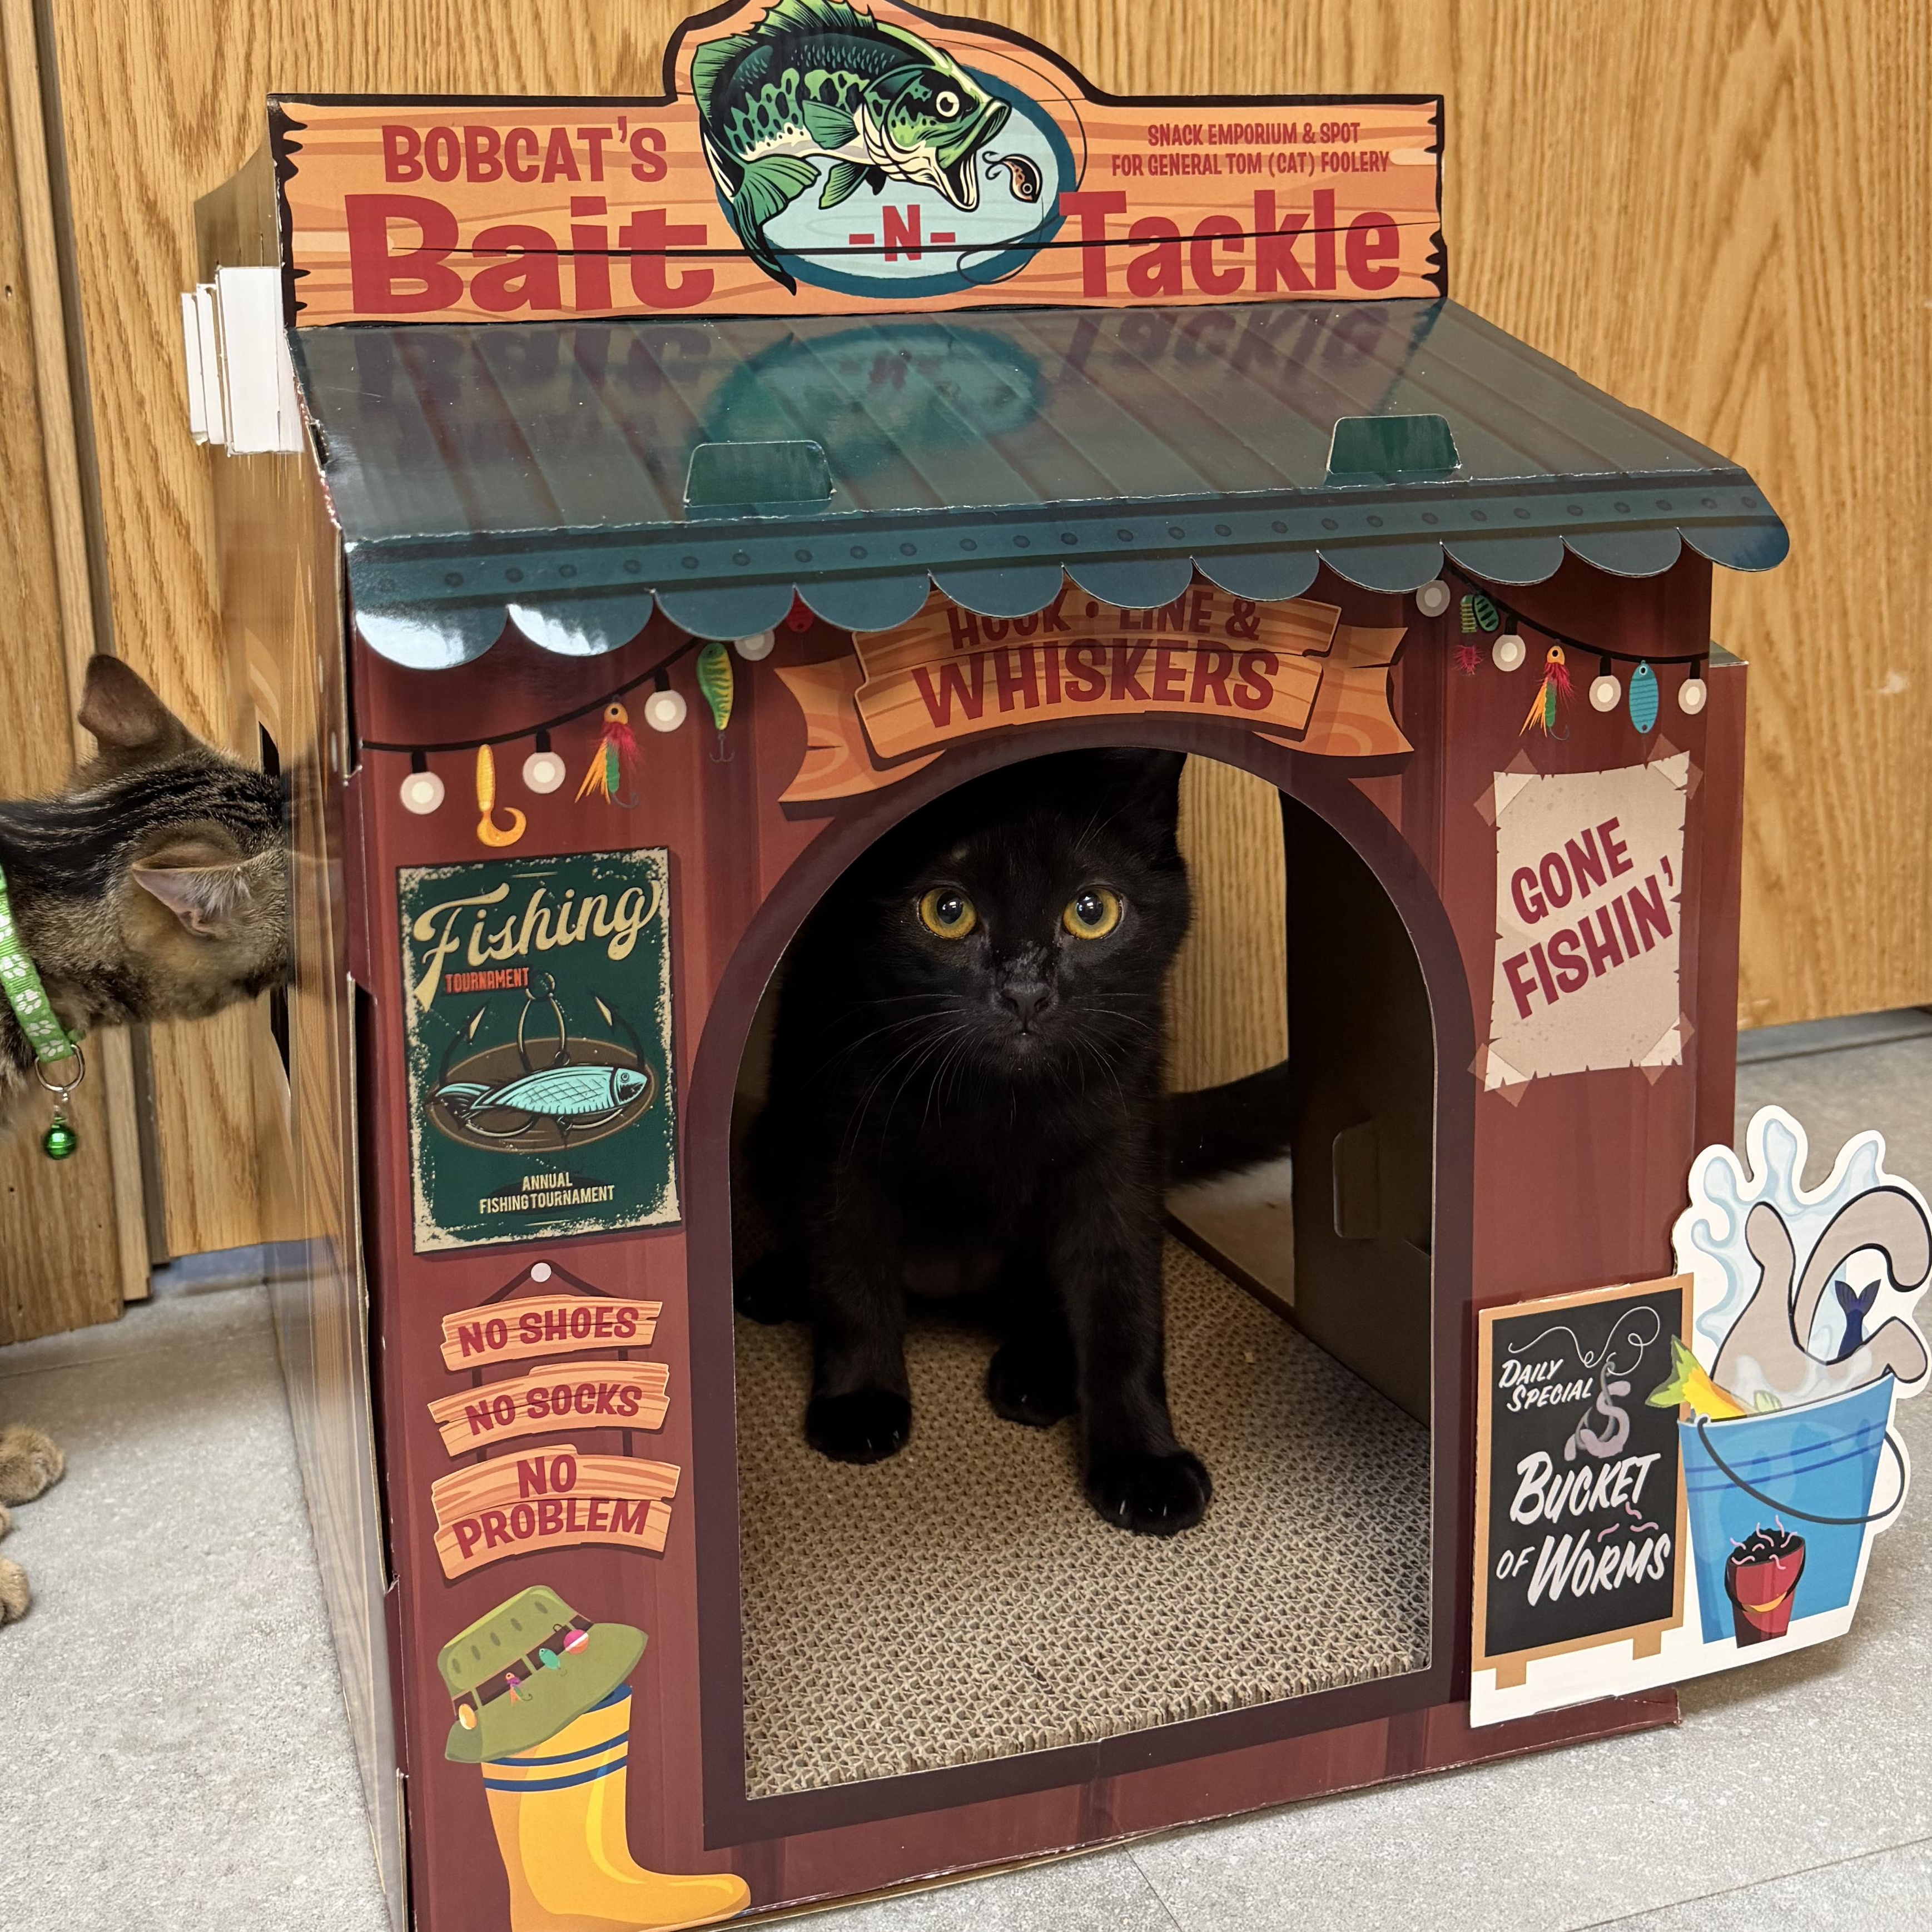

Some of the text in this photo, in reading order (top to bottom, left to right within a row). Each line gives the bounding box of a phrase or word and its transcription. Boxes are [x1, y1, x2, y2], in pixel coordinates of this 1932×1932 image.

[382, 116, 667, 183] BOBCAT'S
[1148, 122, 1360, 146] SNACK EMPORIUM & SPOT
[1112, 150, 1390, 178] FOR GENERAL TOM (CAT) FOOLERY
[345, 193, 714, 314] Bait
[1059, 188, 1400, 298] Tackle
[1225, 598, 1260, 640] &
[912, 638, 1280, 728] WHISKERS
[1511, 816, 1633, 925] GONE
[413, 880, 663, 1011] Fishing
[1502, 855, 1675, 1020] FISHIN'
[445, 966, 529, 994] TOURNAMENT
[479, 1185, 615, 1214] FISHING TOURNAMENT
[522, 1172, 573, 1191] ANNUAL
[458, 1307, 639, 1357] NO SHOES
[1499, 1359, 1564, 1388] DAILY
[1507, 1377, 1593, 1412] SPECIAL
[464, 1383, 643, 1436] NO SOCKS
[516, 1454, 577, 1498] NO
[1509, 1451, 1661, 1525] BUCKET
[451, 1498, 652, 1559] PROBLEM
[1496, 1529, 1671, 1607] OF WORMS
